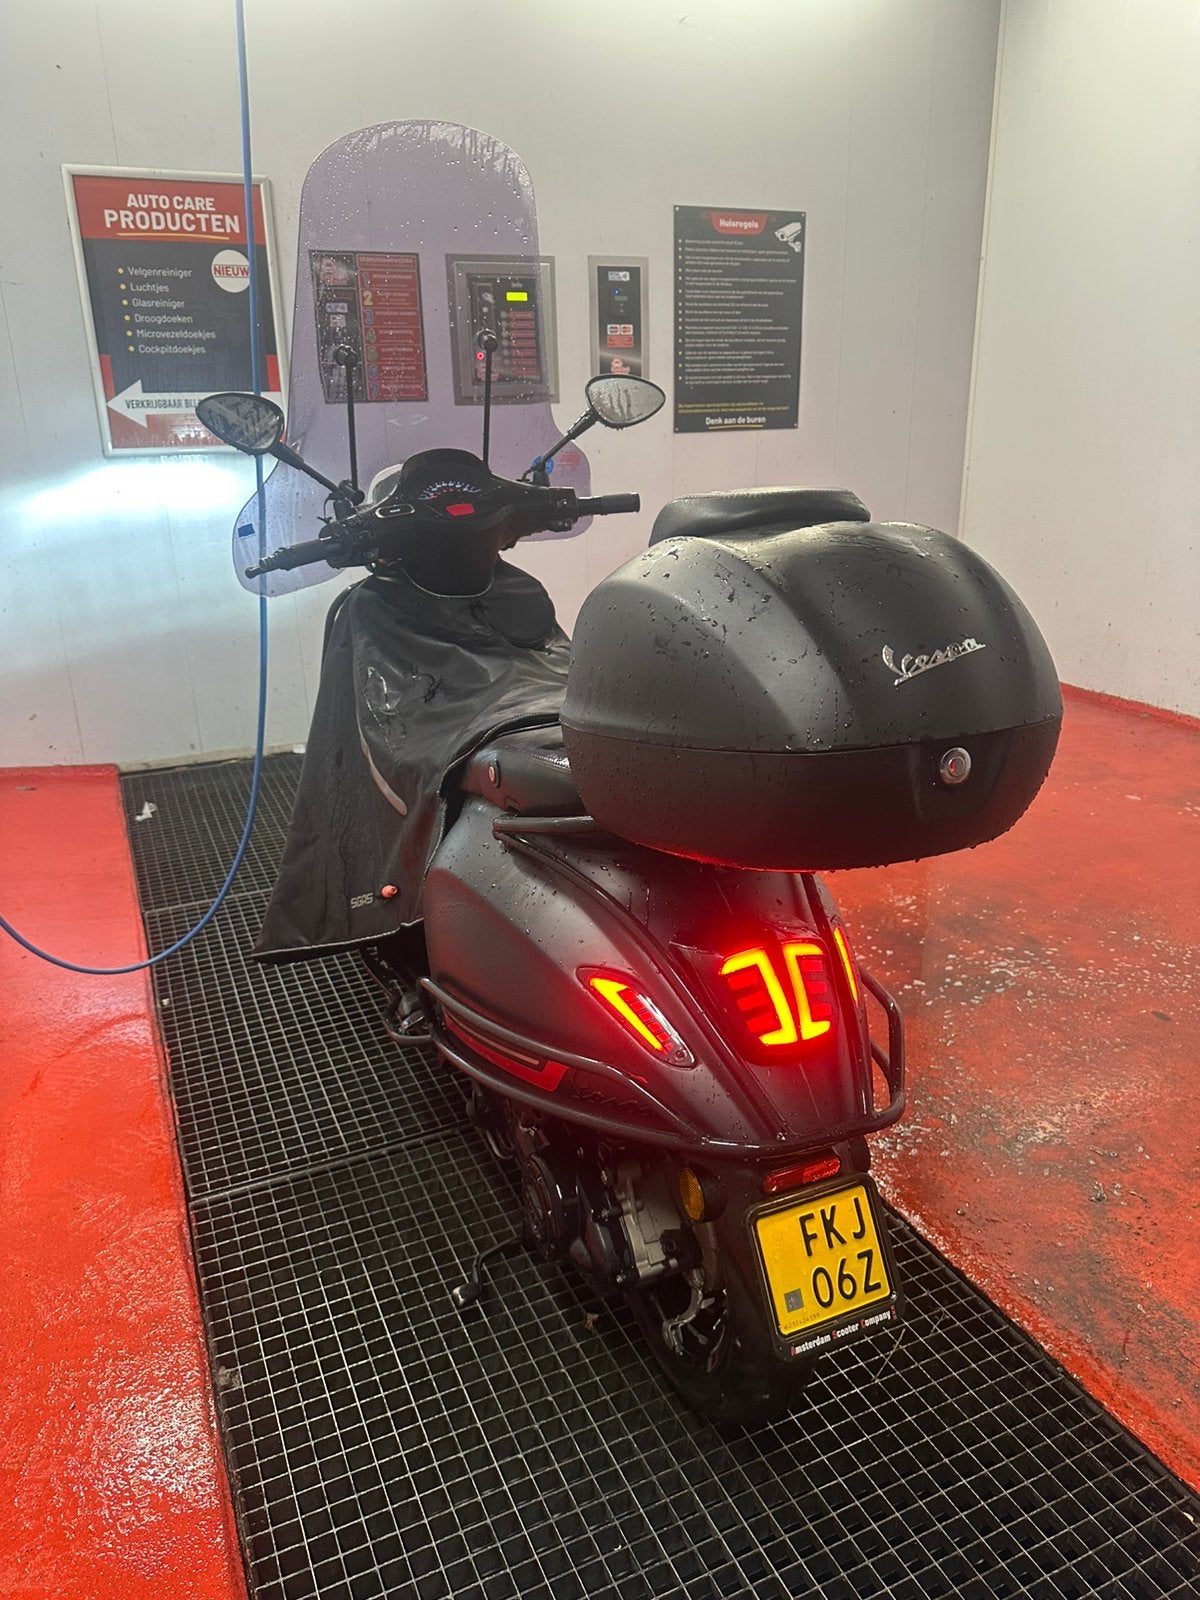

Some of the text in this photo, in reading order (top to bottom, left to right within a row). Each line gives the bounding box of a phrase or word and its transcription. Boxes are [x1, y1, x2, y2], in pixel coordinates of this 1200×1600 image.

[127, 193, 216, 211] AUTO CARE
[104, 209, 240, 233] PRODUCTEN
[719, 218, 759, 230] Huisregels
[127, 266, 192, 278] Velgenreiniger
[213, 266, 249, 277] NIEUW
[130, 282, 170, 293] Luchtjes
[132, 298, 186, 309] Glasreiniger
[363, 290, 373, 306] 2
[134, 313, 193, 324] Droogdoeken
[136, 329, 217, 340] Microvezeldoekjes
[138, 344, 206, 355] Cockpitdoekjes
[125, 398, 184, 409] VERKRIJGBAAR
[705, 416, 767, 426] Denk aan de buren
[882, 638, 987, 686] Vespa
[799, 1197, 866, 1257] FKJ
[811, 1248, 882, 1308] 06Z
[789, 1310, 892, 1357] Amsterdam Scooter Company
